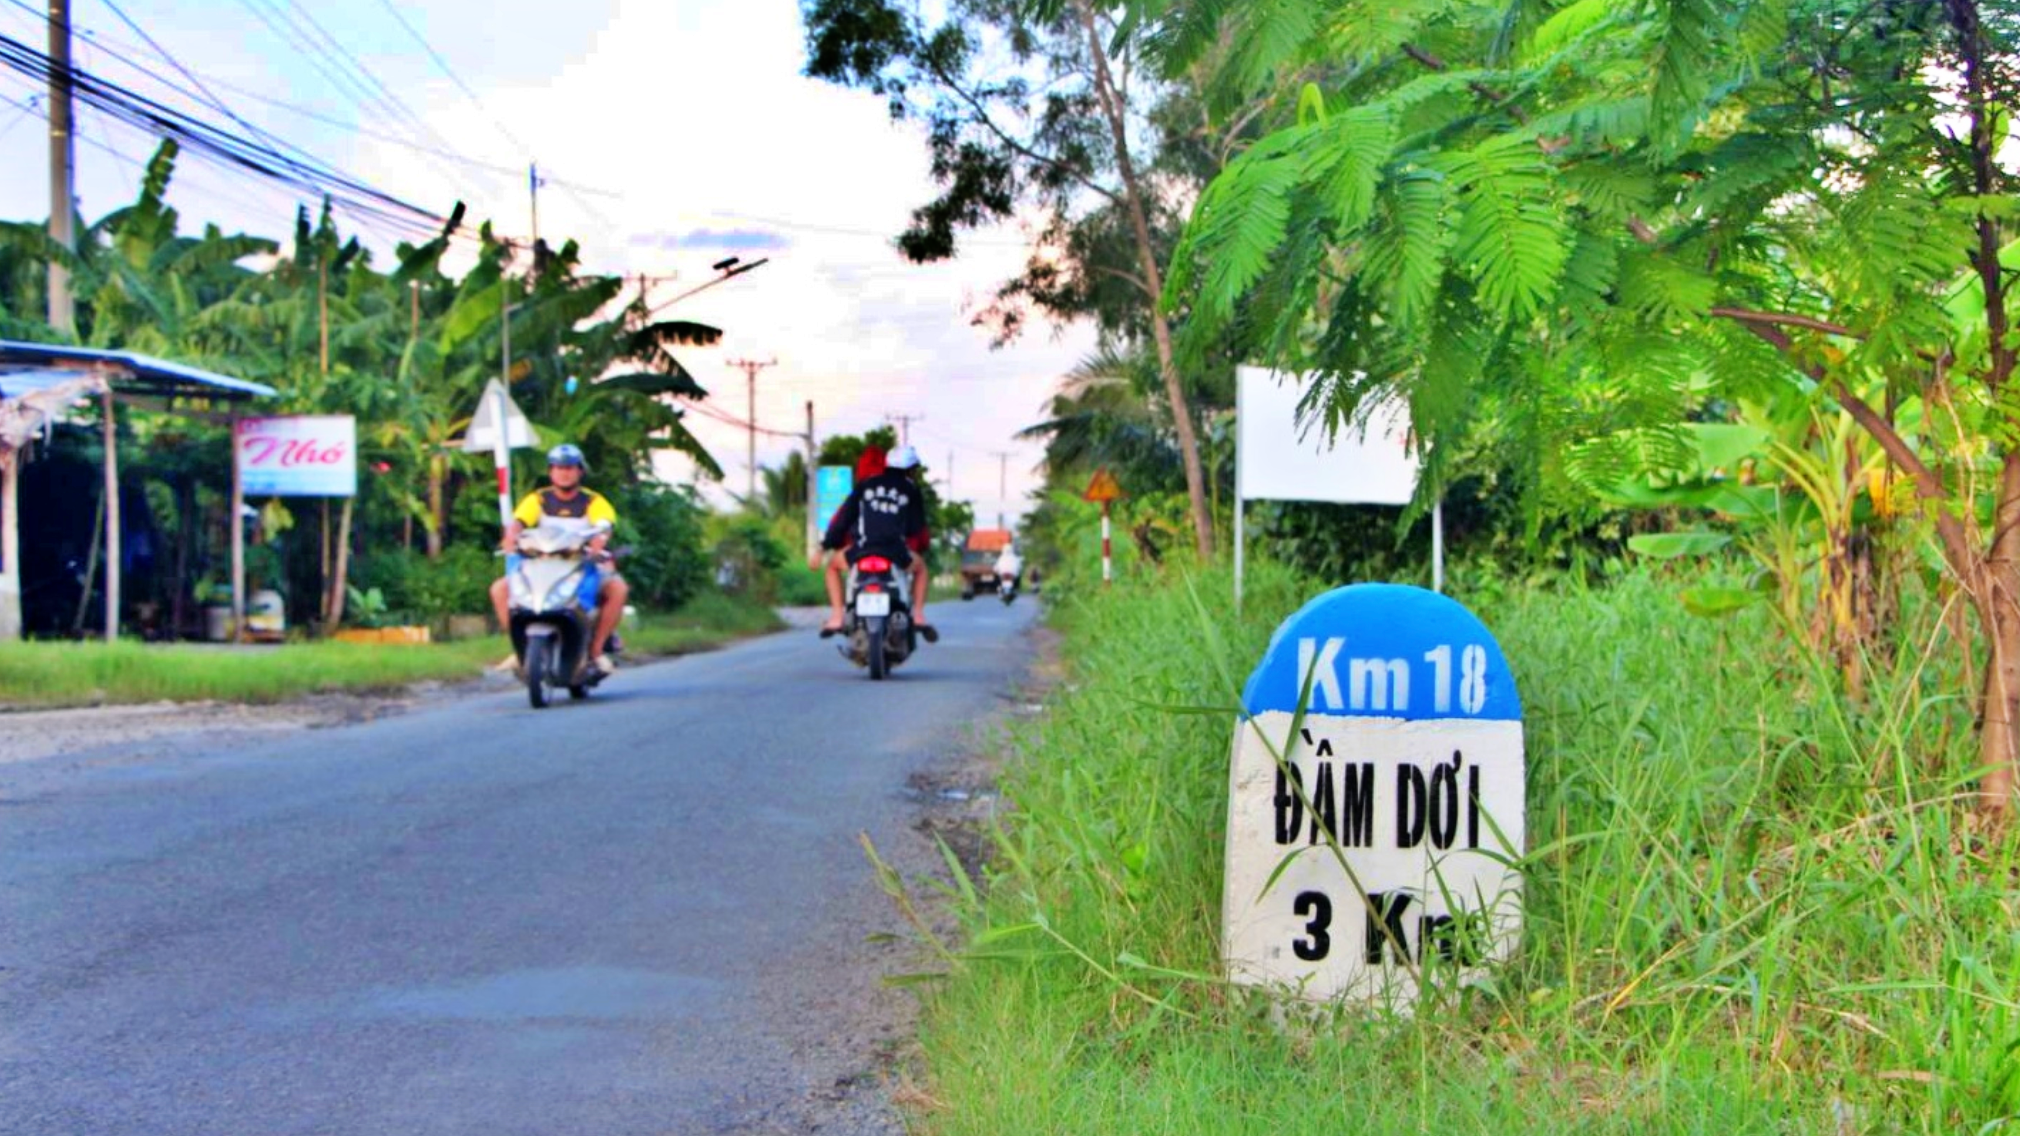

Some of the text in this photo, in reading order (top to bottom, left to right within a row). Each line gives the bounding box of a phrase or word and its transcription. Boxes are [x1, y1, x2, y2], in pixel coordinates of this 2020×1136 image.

[1297, 636, 1487, 714] Km 18
[1273, 728, 1481, 850] ĐẦM DƠI
[1292, 891, 1333, 962] 3
